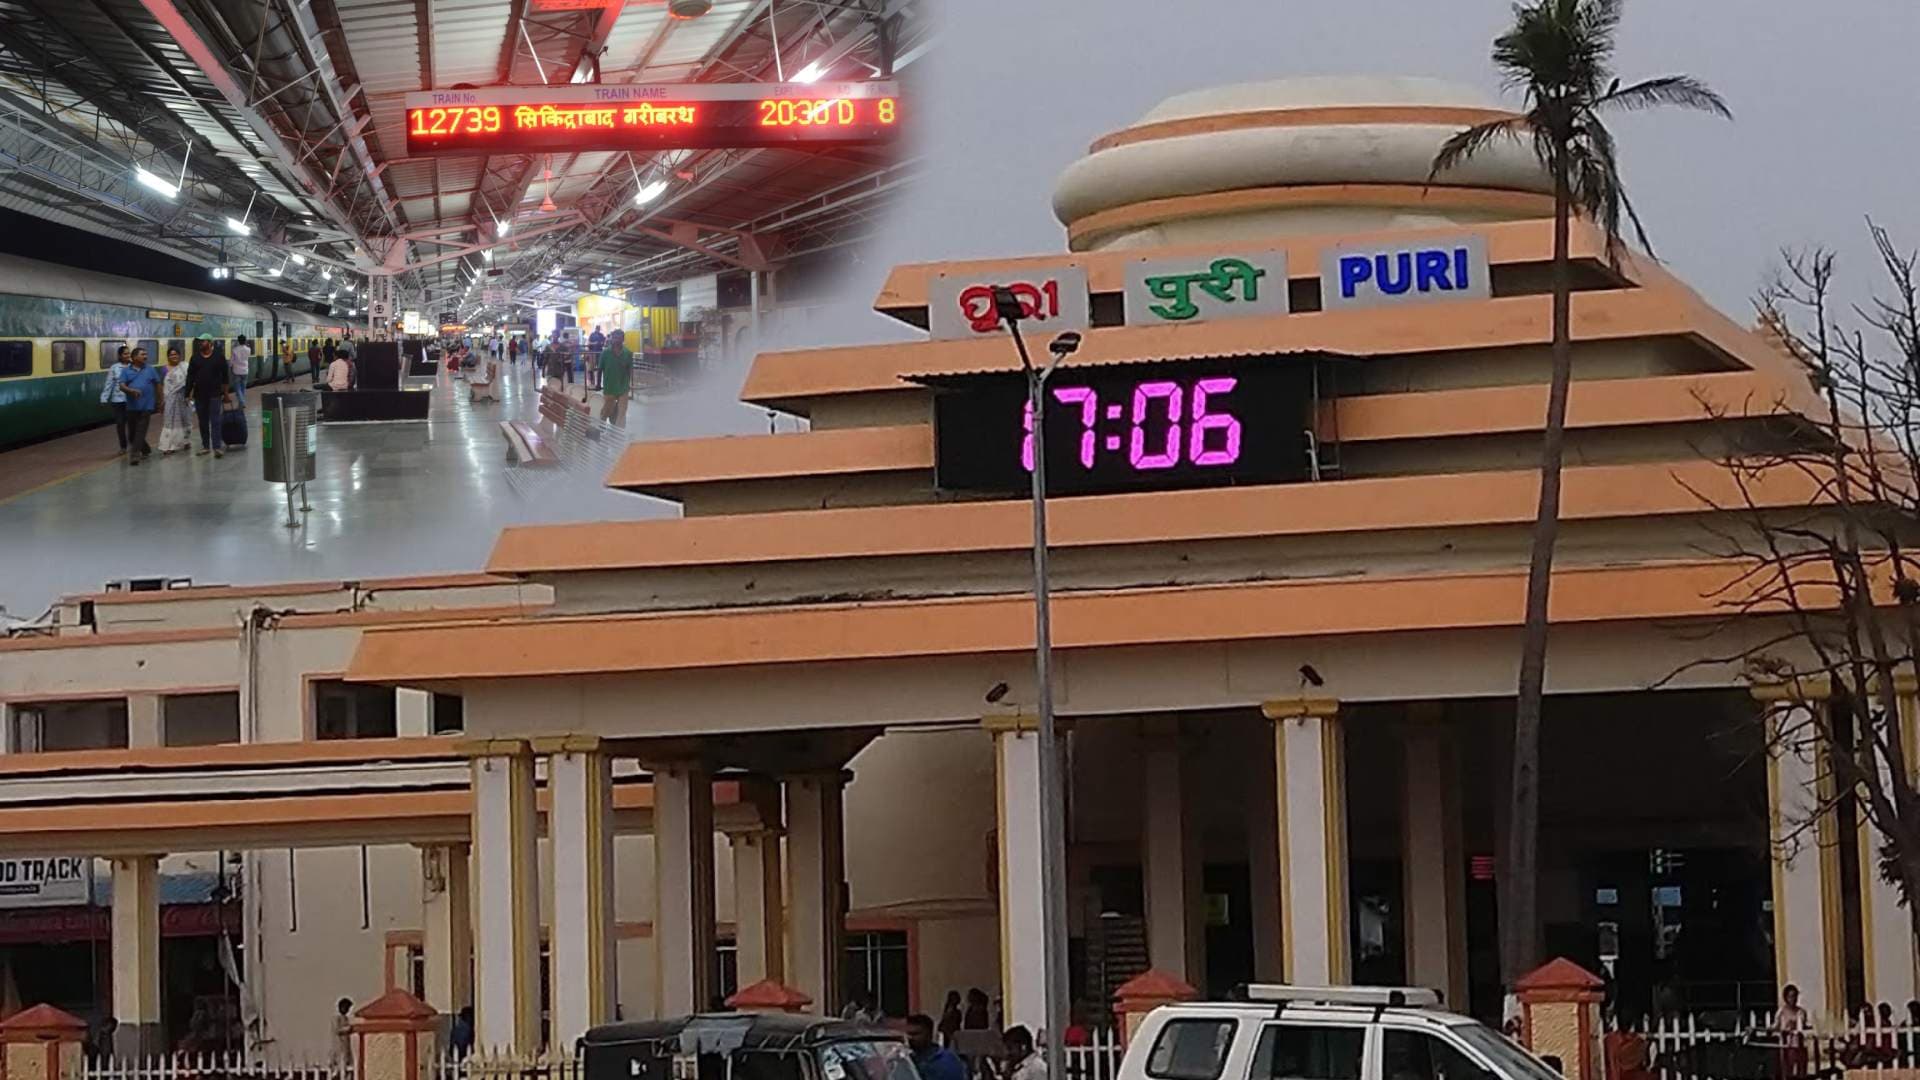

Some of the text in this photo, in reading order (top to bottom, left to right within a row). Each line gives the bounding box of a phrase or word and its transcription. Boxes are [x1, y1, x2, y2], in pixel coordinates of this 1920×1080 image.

[432, 94, 460, 104] TRAIN
[595, 87, 666, 99] TRAIN NAME
[411, 107, 501, 135] 12739
[624, 102, 695, 125] गरीबरथ
[838, 99, 854, 124] D
[878, 98, 895, 123] 8
[1340, 249, 1468, 297] PURI
[1144, 259, 1264, 320] पुरी
[1022, 378, 1241, 471] 17:06
[21, 857, 82, 887] TRACK
